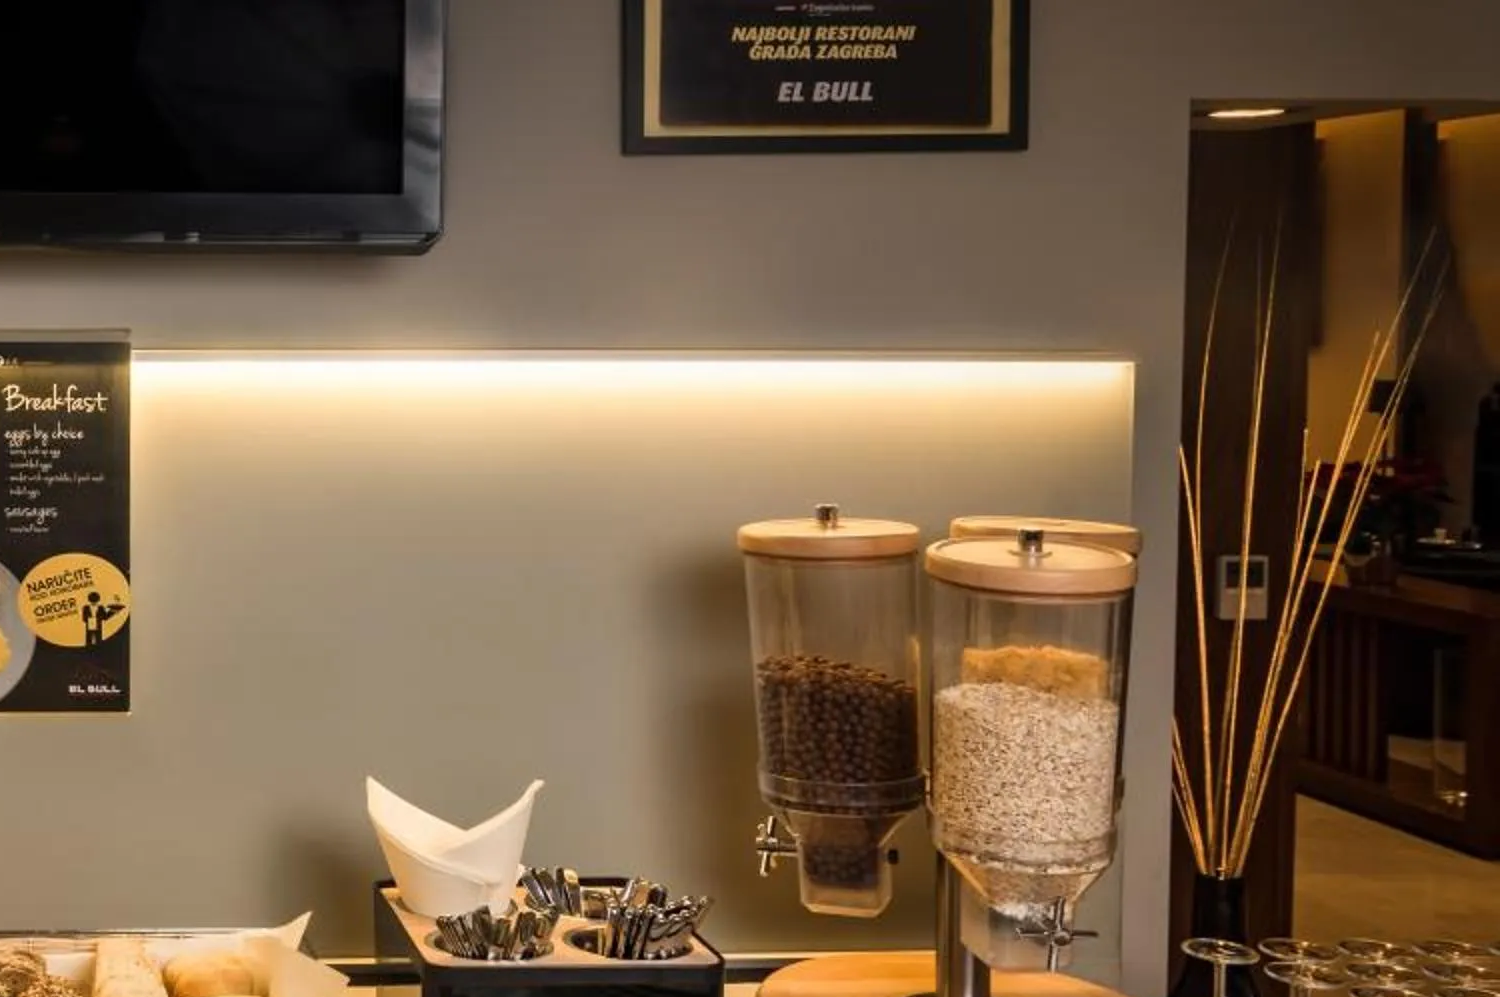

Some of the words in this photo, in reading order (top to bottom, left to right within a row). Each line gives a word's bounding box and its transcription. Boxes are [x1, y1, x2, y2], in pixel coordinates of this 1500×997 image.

[731, 26, 811, 46] NAJBOLJI
[815, 24, 916, 41] RESTORANI
[749, 43, 811, 60] GRADA
[815, 43, 898, 60] ZAGREBA
[778, 81, 805, 103] EL
[812, 81, 874, 102] BULL
[2, 383, 109, 413] Breakfast
[33, 422, 48, 447] by
[27, 568, 93, 594] NARUČITE
[33, 597, 77, 617] ORDER
